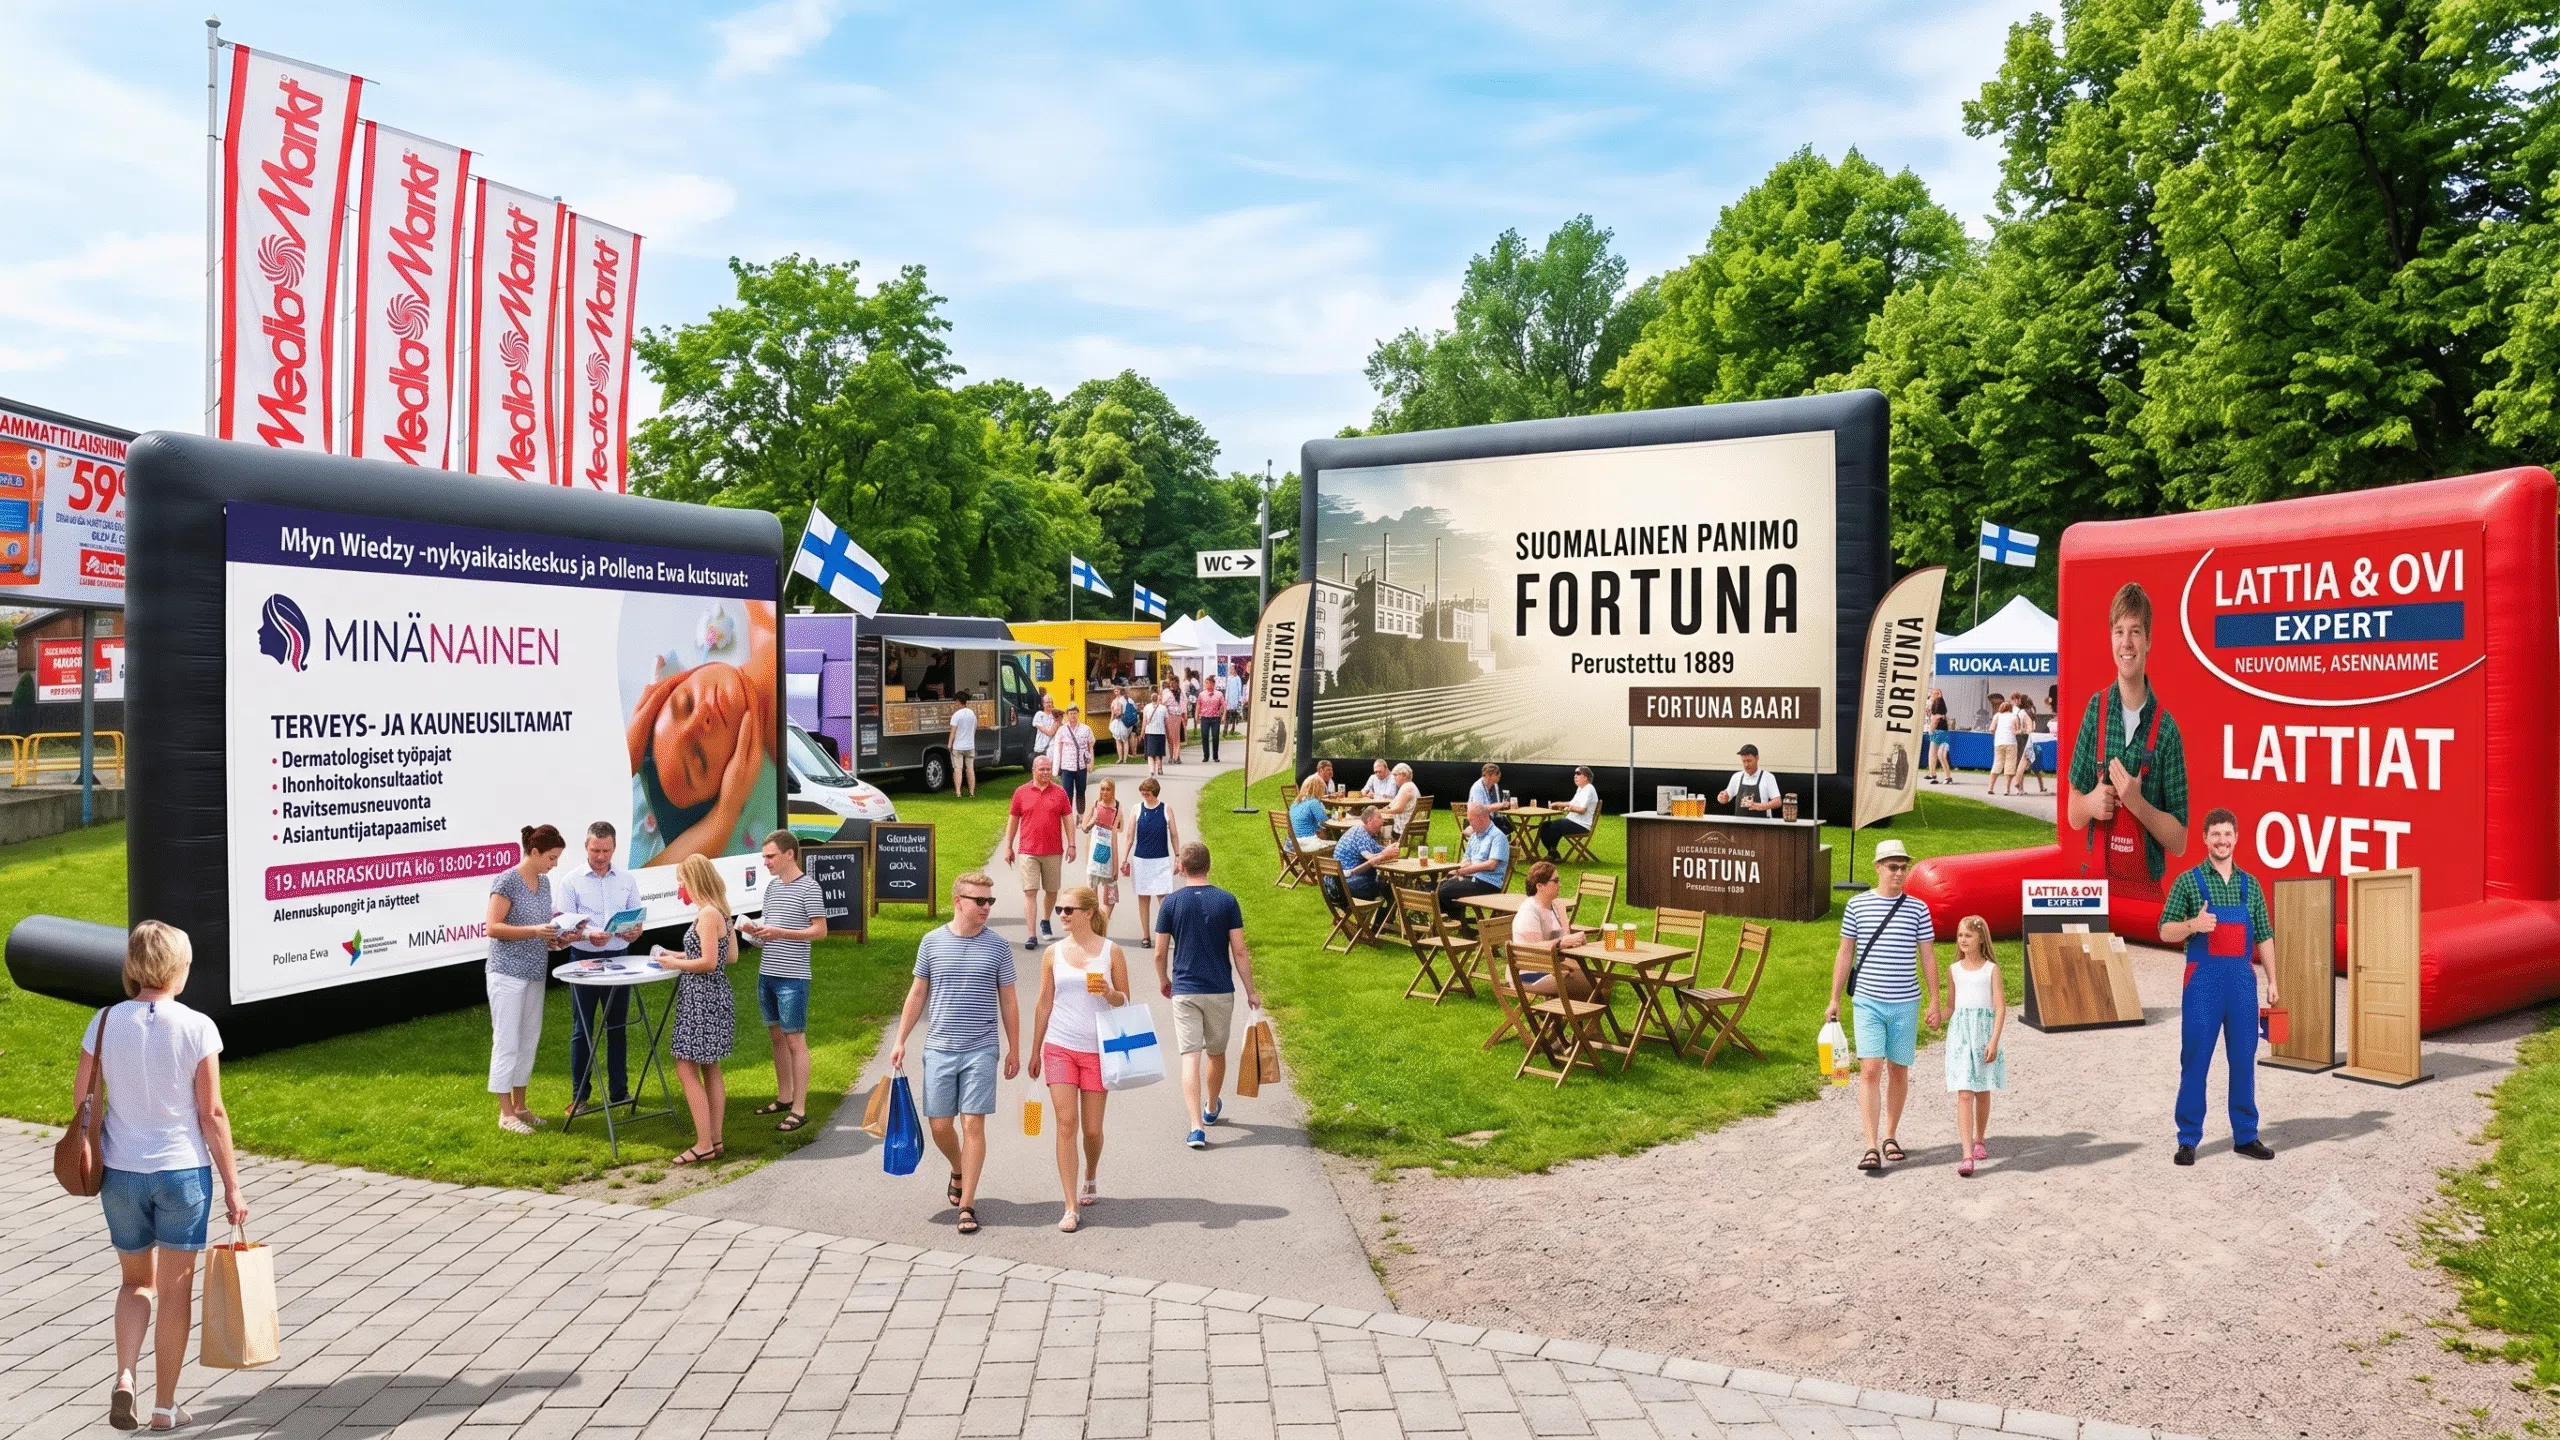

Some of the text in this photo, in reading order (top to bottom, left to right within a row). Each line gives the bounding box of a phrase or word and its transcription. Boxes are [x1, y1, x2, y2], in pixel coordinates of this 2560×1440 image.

[1516, 518, 1799, 561] SUOMALAINEN PANIMO
[280, 526, 335, 560] Młyn
[340, 532, 415, 568] Wiedzy
[580, 554, 596, 581] ja
[600, 556, 654, 581] Pollena
[657, 562, 685, 583] Ewa
[688, 567, 749, 588] kutsuvat:
[1204, 556, 1233, 572] WC
[2215, 548, 2464, 607] LATTIA & OVI
[1516, 563, 1798, 638] FORTUNA
[325, 612, 559, 666] MINÄNAINEN
[2275, 610, 2393, 642] EXPERT
[1269, 621, 1296, 709] FORTUNA
[1571, 651, 1735, 674] Perustettu 1889
[1886, 617, 1924, 734] FORTUNA
[1949, 657, 2050, 673] RUOKA-ALUE
[2234, 652, 2439, 674] NEUVOMME, ASENNAMME
[1647, 695, 1801, 720] FORTUNA BAARI
[271, 711, 573, 739] TERVEYS- JA KAUNEUSILTAMAT
[282, 746, 452, 769] Dermatologiset työpajat
[2223, 724, 2456, 791] LATTIAT
[282, 769, 444, 794] Ihonhoitokonsultaatiot
[282, 794, 432, 819] Ravitsemusneuvonta
[282, 816, 447, 845] Asiantuntijatapaamiset
[2255, 811, 2412, 877] OVET
[274, 849, 511, 892] 19. MARRASKUUTA klo 18:00-21:00
[1672, 856, 1761, 884] FORTUNA
[2028, 886, 2103, 897] LATTIA & OVI
[2047, 898, 2085, 907] EXPERT
[273, 892, 420, 923] Alennuskupongit ja näytteet
[273, 949, 329, 966] Pollena Ewa
